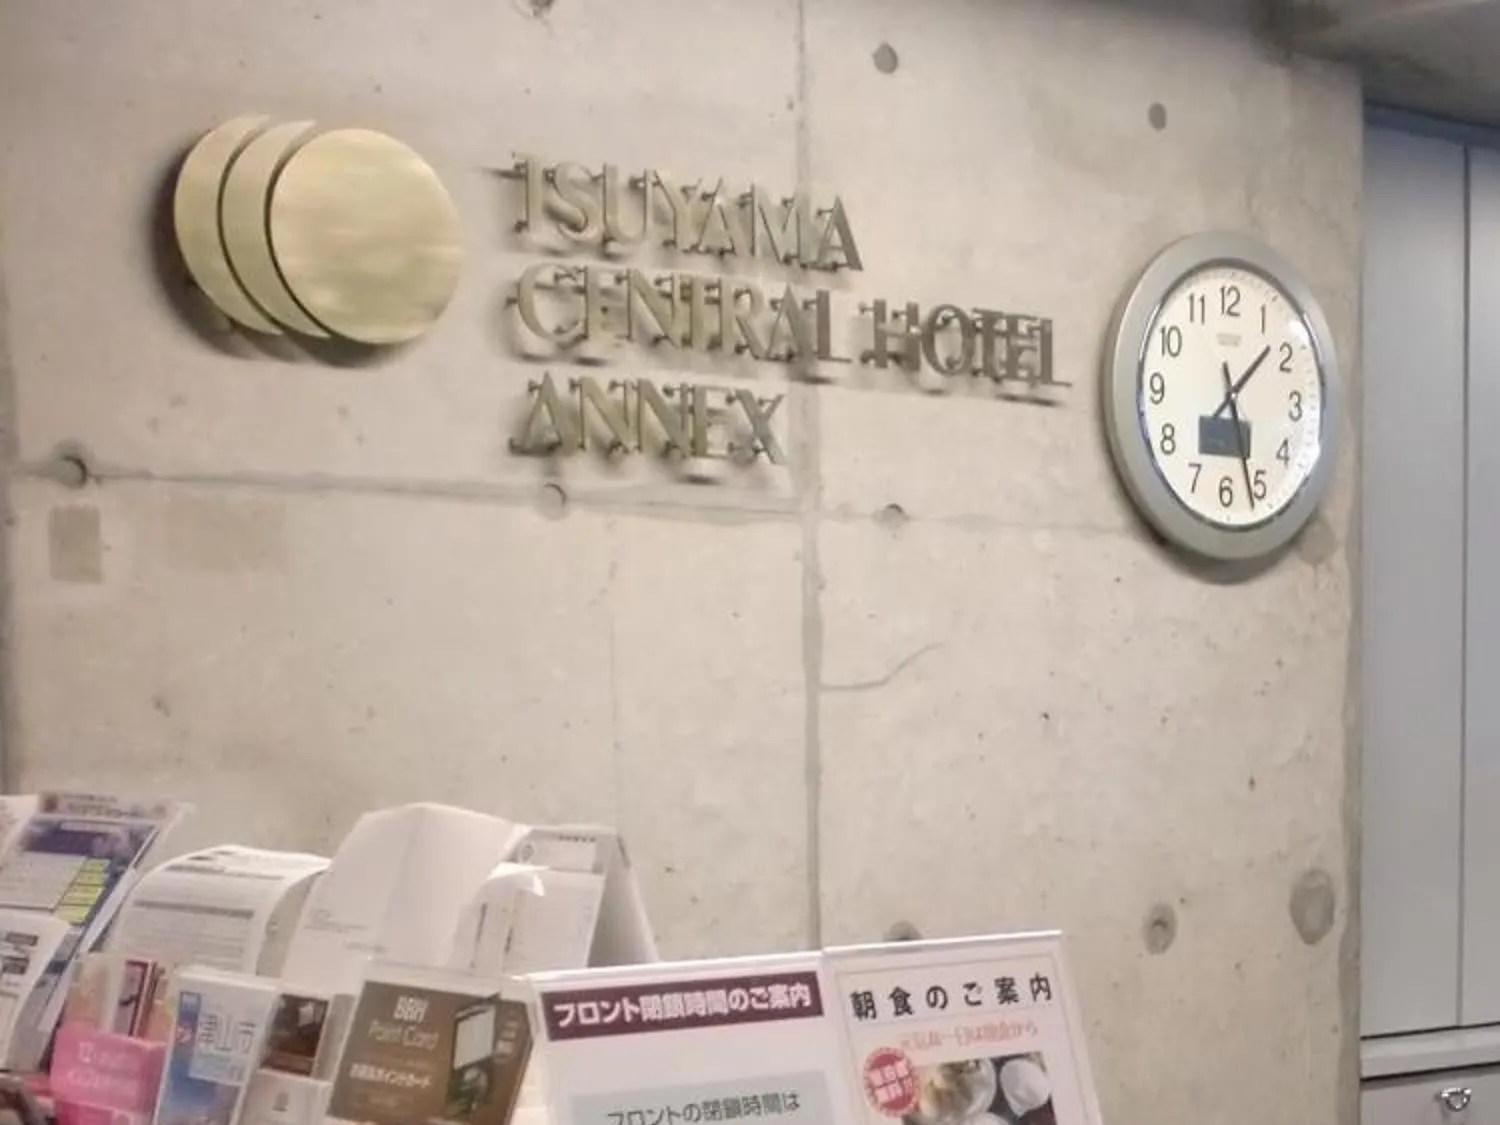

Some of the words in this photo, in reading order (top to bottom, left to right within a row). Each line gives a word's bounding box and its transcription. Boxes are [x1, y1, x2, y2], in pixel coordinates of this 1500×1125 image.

[1187, 293, 1206, 326] 11
[1220, 285, 1241, 317] 12
[516, 262, 853, 364] CENTRAL
[872, 298, 1073, 388] HOTEL
[1260, 303, 1268, 335] 1
[1160, 325, 1183, 359] 10
[1279, 342, 1293, 373] 2
[1149, 372, 1165, 405] 9
[509, 371, 787, 466] ANNEX
[1288, 390, 1302, 421] 3
[1160, 422, 1176, 455] 8
[1275, 437, 1290, 469] 4
[1187, 462, 1203, 494] 7
[1218, 476, 1233, 508] 6
[1252, 469, 1268, 501] 5
[851, 972, 1052, 1021] 朝食のご案内
